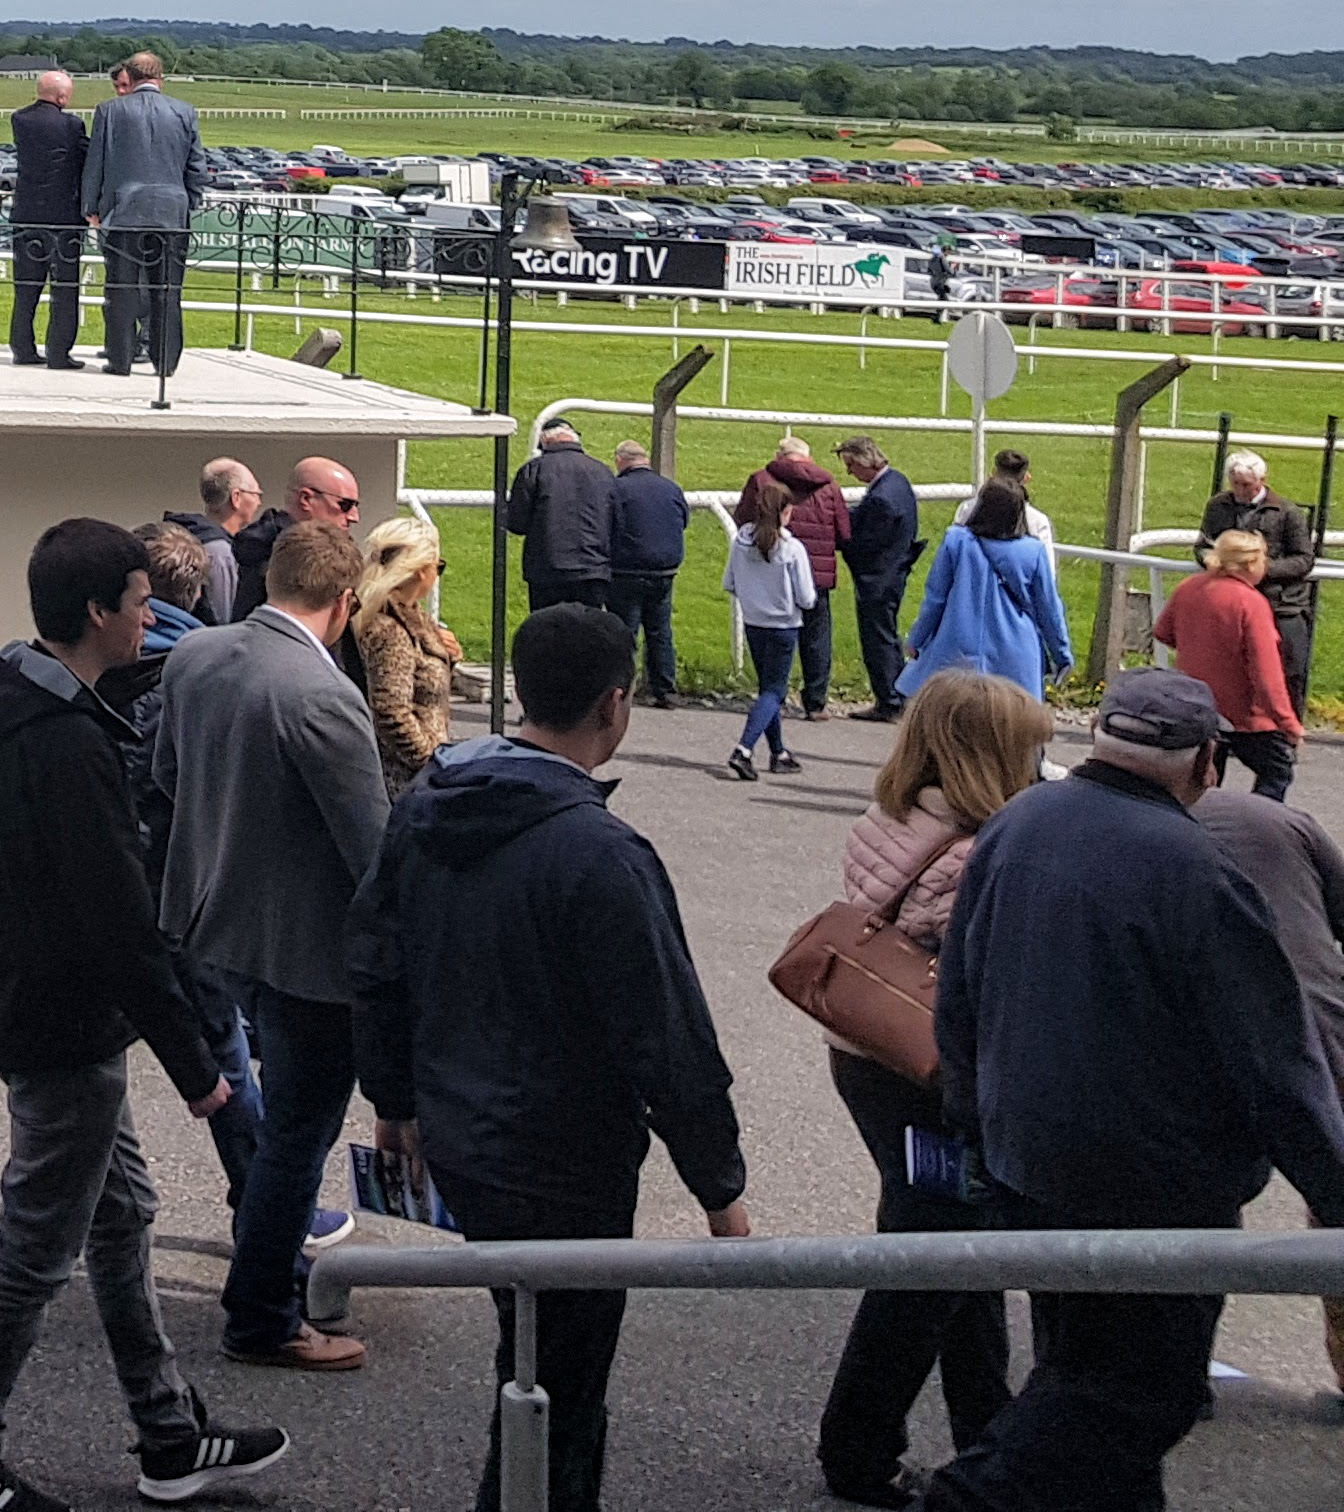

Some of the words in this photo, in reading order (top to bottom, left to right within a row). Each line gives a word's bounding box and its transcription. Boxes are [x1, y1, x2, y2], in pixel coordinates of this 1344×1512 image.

[218, 233, 304, 251] STALLON
[736, 246, 759, 259] THE
[624, 245, 669, 279] TV
[735, 261, 791, 285] IRISH
[797, 264, 855, 287] FIELD
